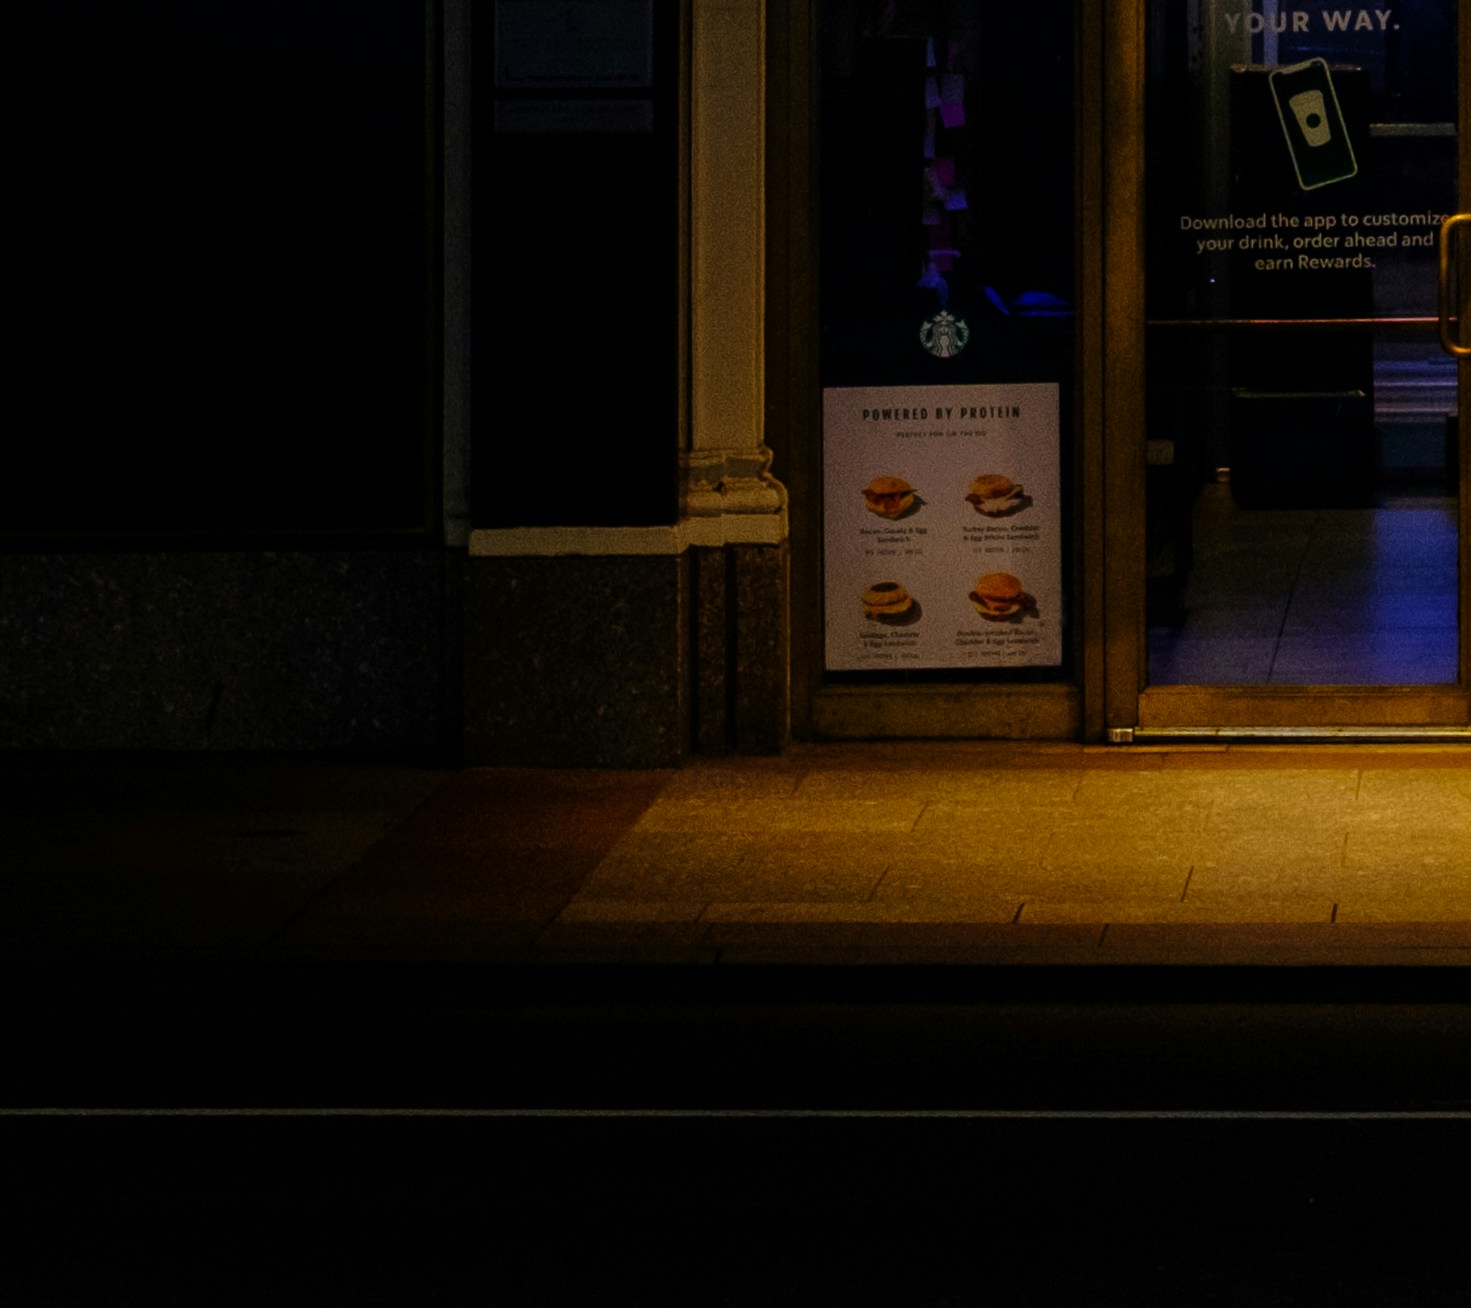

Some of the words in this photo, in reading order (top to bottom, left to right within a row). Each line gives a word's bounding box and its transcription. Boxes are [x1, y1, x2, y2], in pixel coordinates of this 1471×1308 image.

[1225, 11, 1310, 34] YOUR
[1322, 9, 1400, 32] WAY.
[1180, 213, 1267, 231] Download
[1271, 212, 1299, 229] the
[1304, 215, 1336, 234] app
[1340, 213, 1358, 228] to
[1196, 239, 1235, 255] your
[1239, 234, 1289, 252] drink,
[1293, 233, 1341, 249] order
[1344, 232, 1397, 249] ahead
[1402, 231, 1434, 247] and
[1254, 257, 1293, 271] earn
[1298, 253, 1377, 270] Rewards.
[863, 407, 928, 421] POWERED
[936, 407, 952, 419] BY
[960, 405, 1021, 419] PROTEIN
